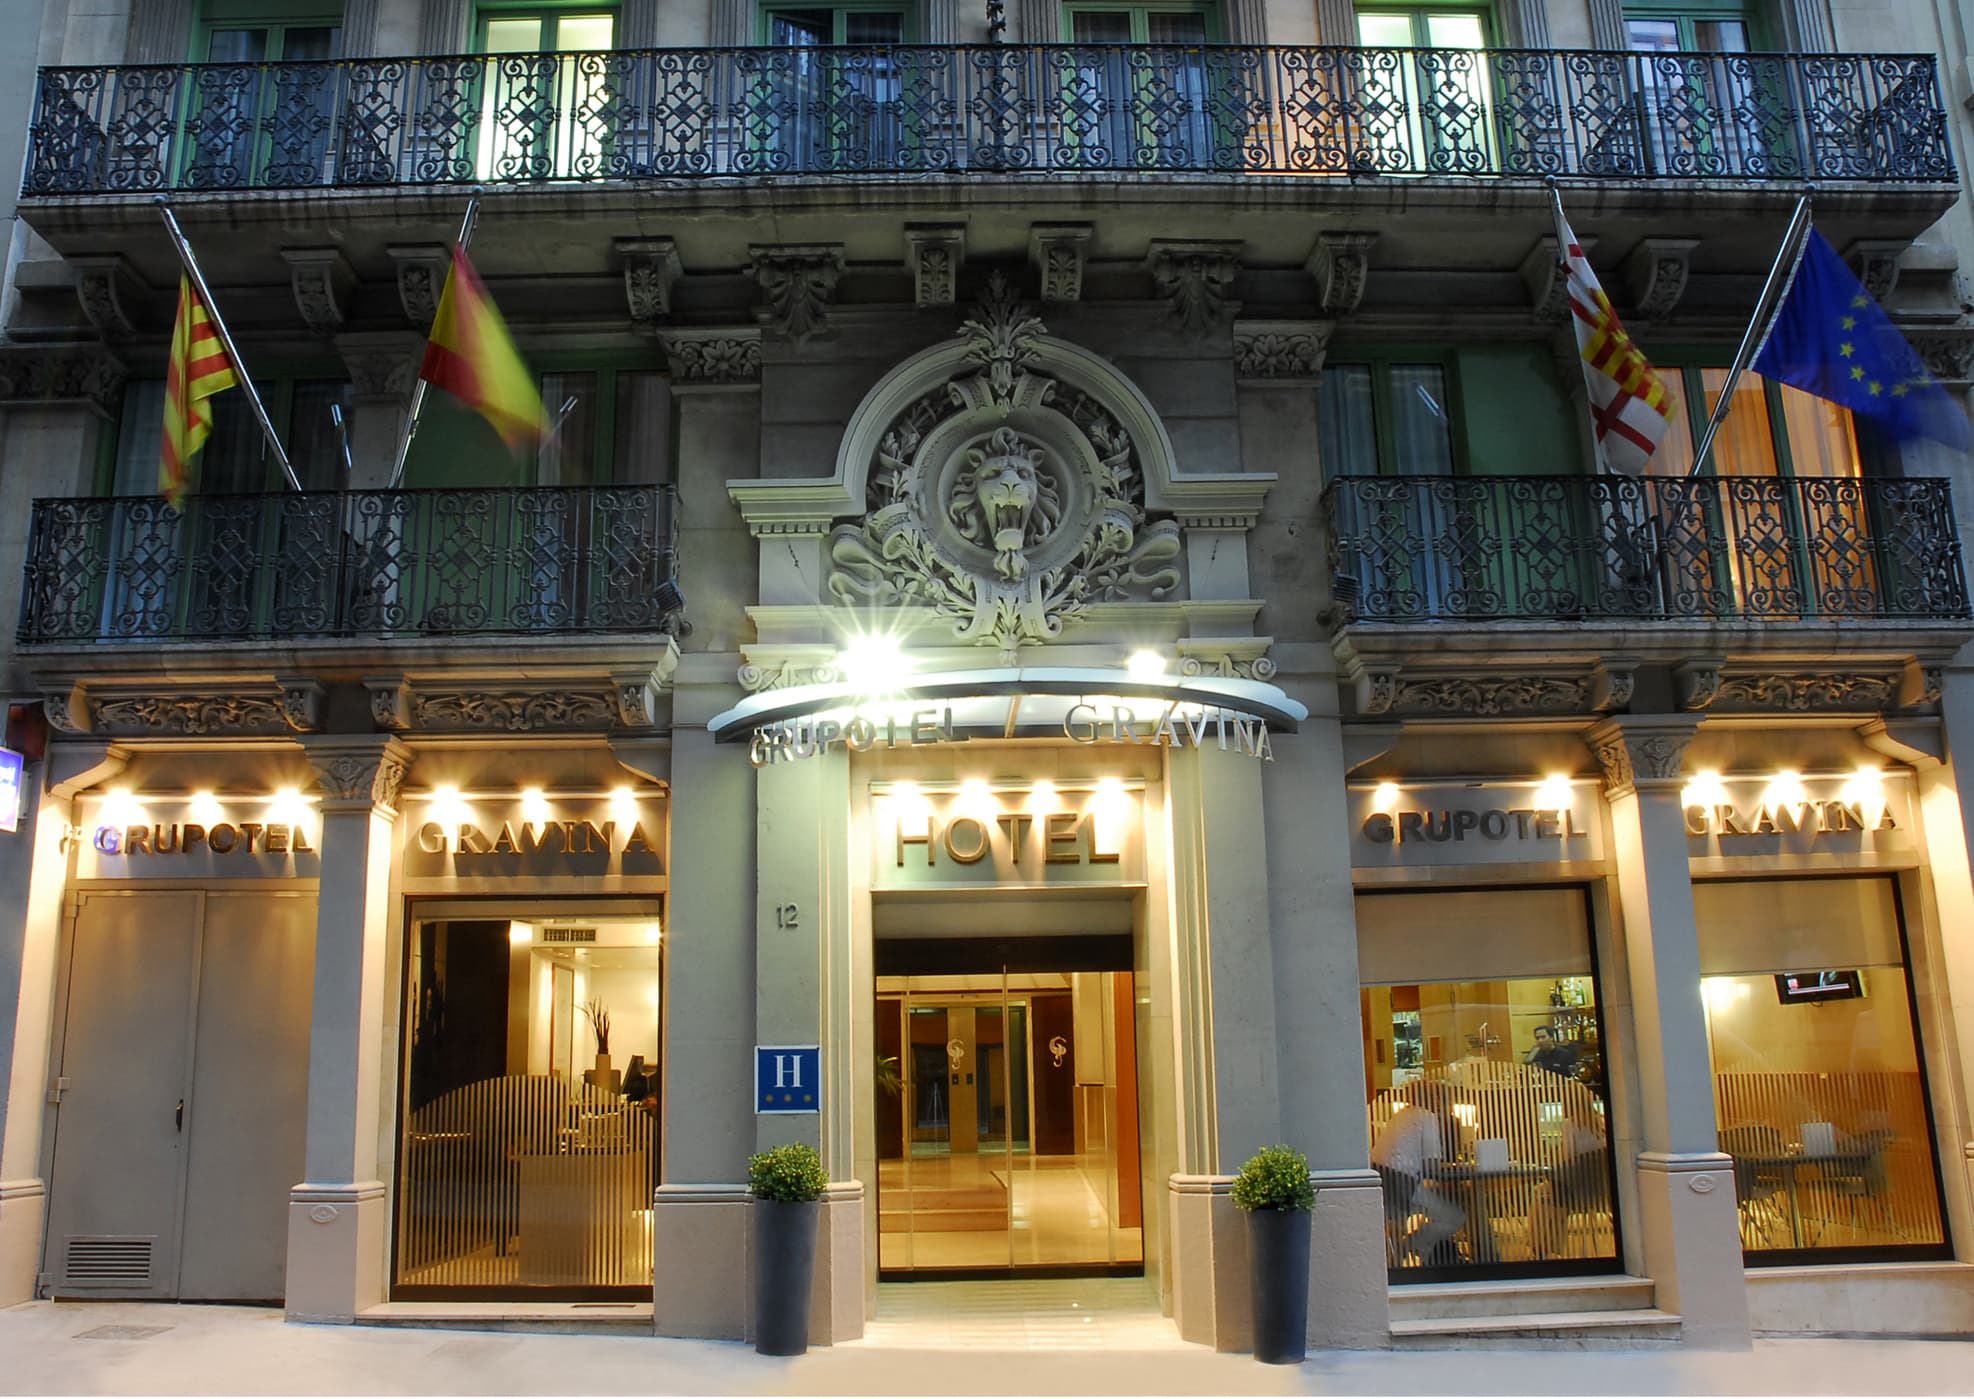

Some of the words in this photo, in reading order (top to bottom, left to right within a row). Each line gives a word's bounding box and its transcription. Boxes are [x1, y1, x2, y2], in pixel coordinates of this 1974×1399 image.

[750, 706, 971, 768] GRUPOTEL
[1064, 703, 1275, 762] GRAVINA
[1363, 808, 1588, 844] GRUPOTEL
[1683, 800, 1904, 836] GRAVINA
[94, 822, 313, 856] GRUPOTEL
[418, 819, 656, 855] GRAVINA
[897, 813, 1120, 867] HOTEL
[776, 903, 799, 930] 12
[773, 1054, 803, 1088] H
